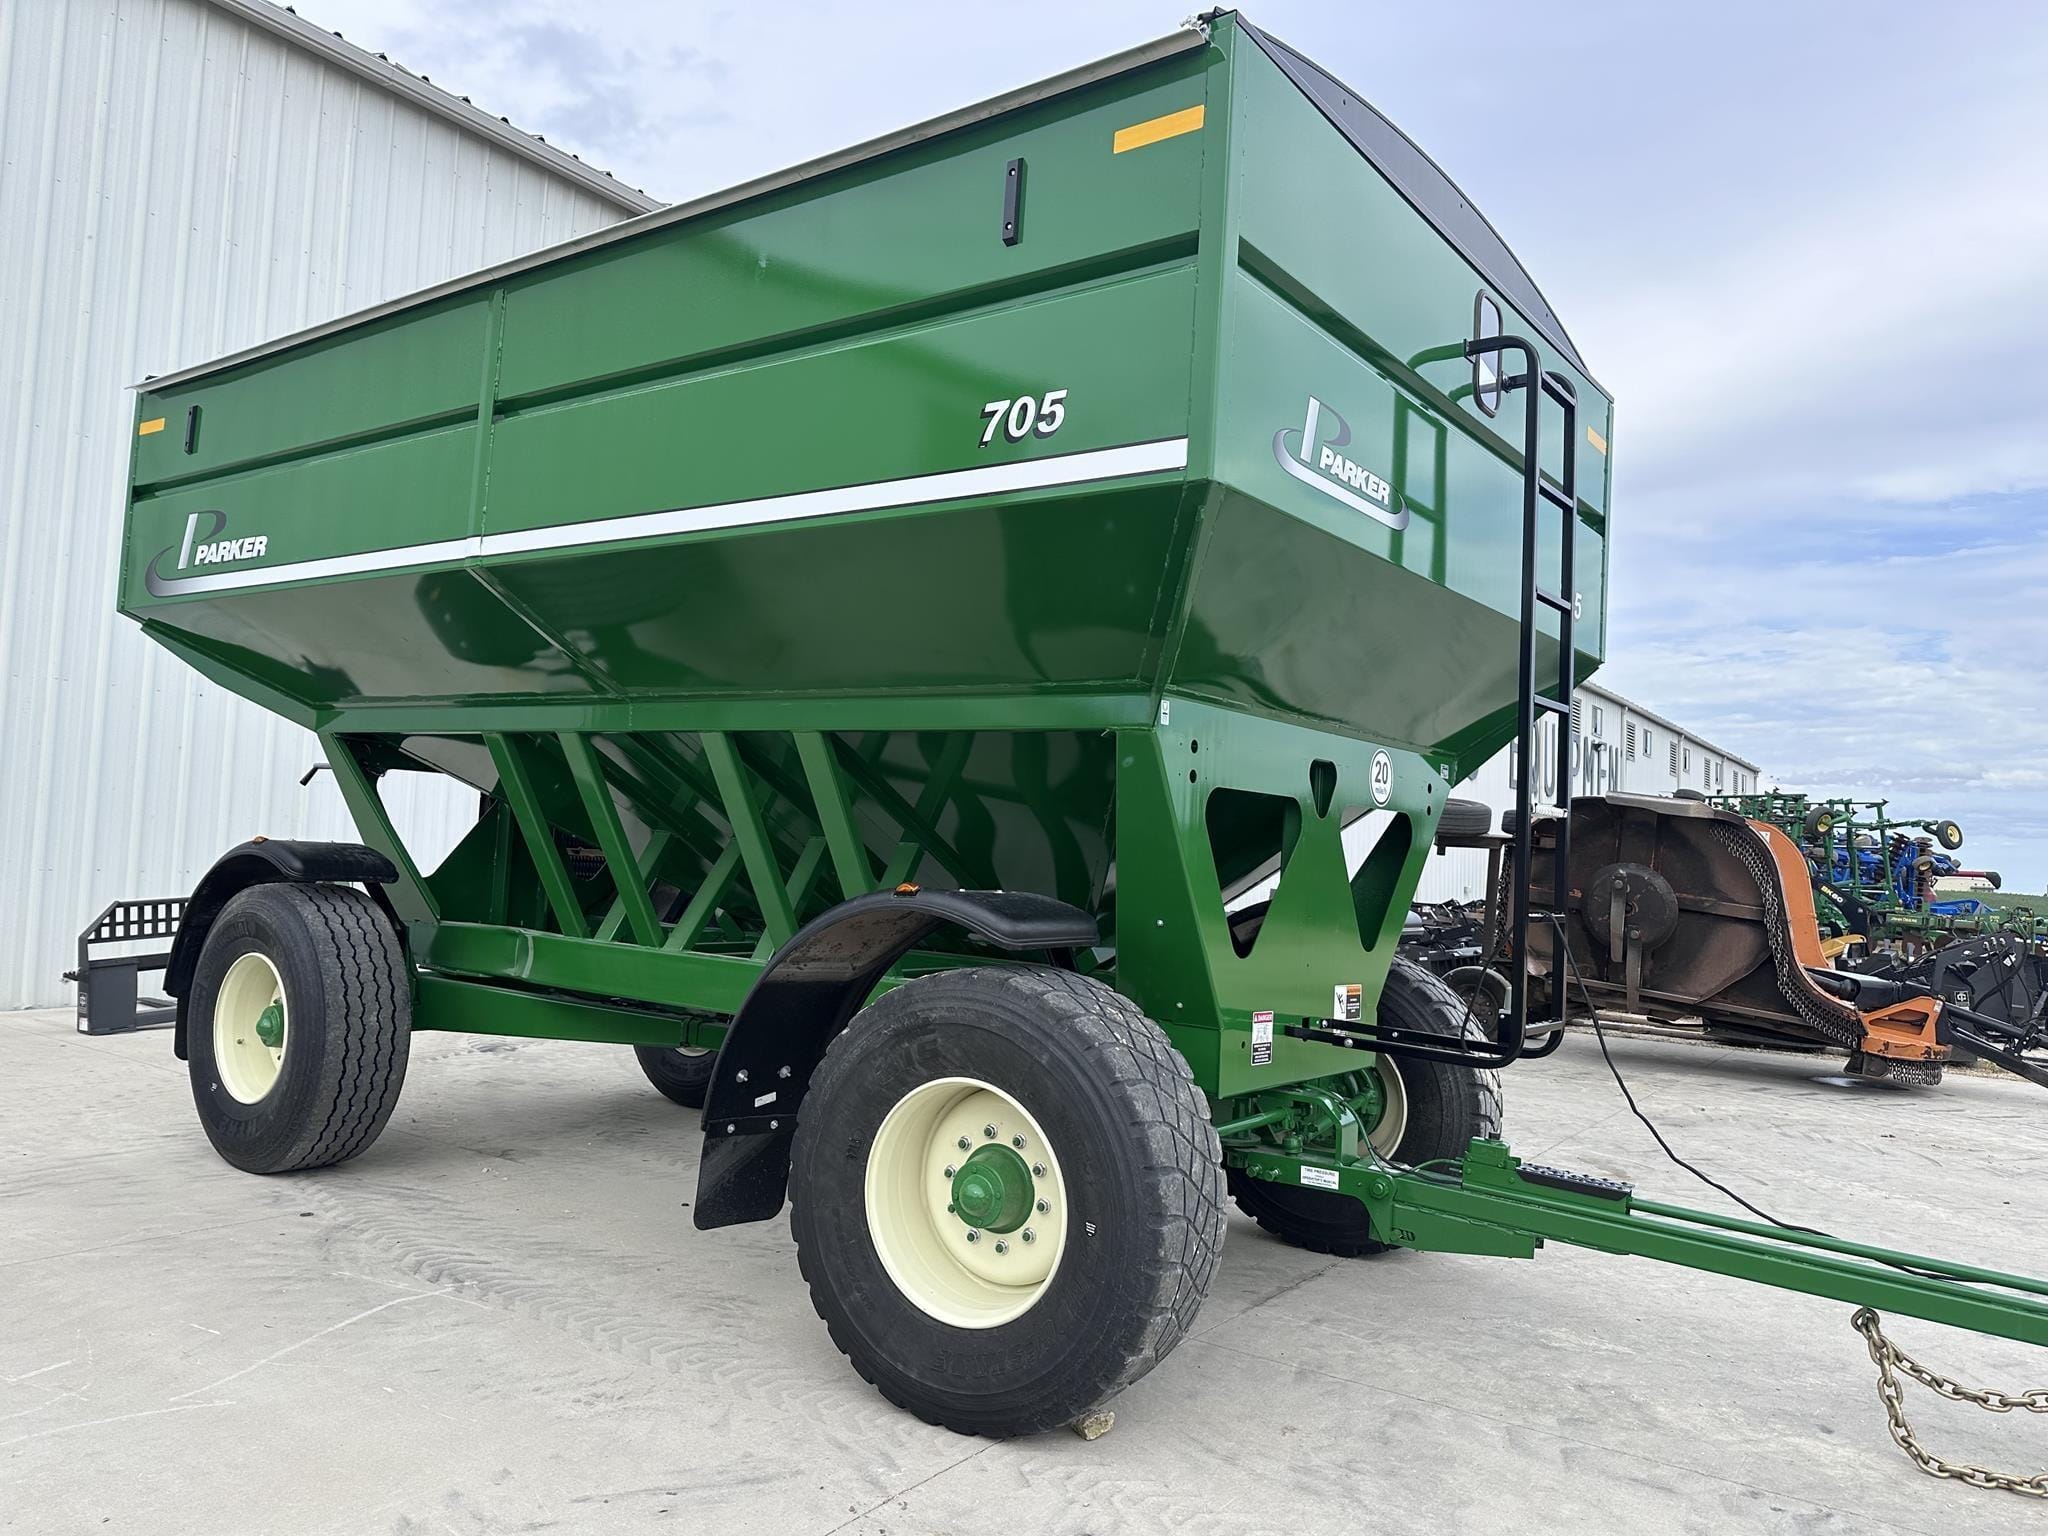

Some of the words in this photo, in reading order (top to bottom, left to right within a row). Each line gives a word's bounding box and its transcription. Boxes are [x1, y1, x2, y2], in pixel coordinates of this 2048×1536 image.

[979, 389, 1068, 448] 705
[1319, 444, 1390, 505] PARKER
[193, 535, 268, 566] PARKER
[1374, 760, 1388, 785] 20
[1509, 720, 1619, 798] QUPMEN
